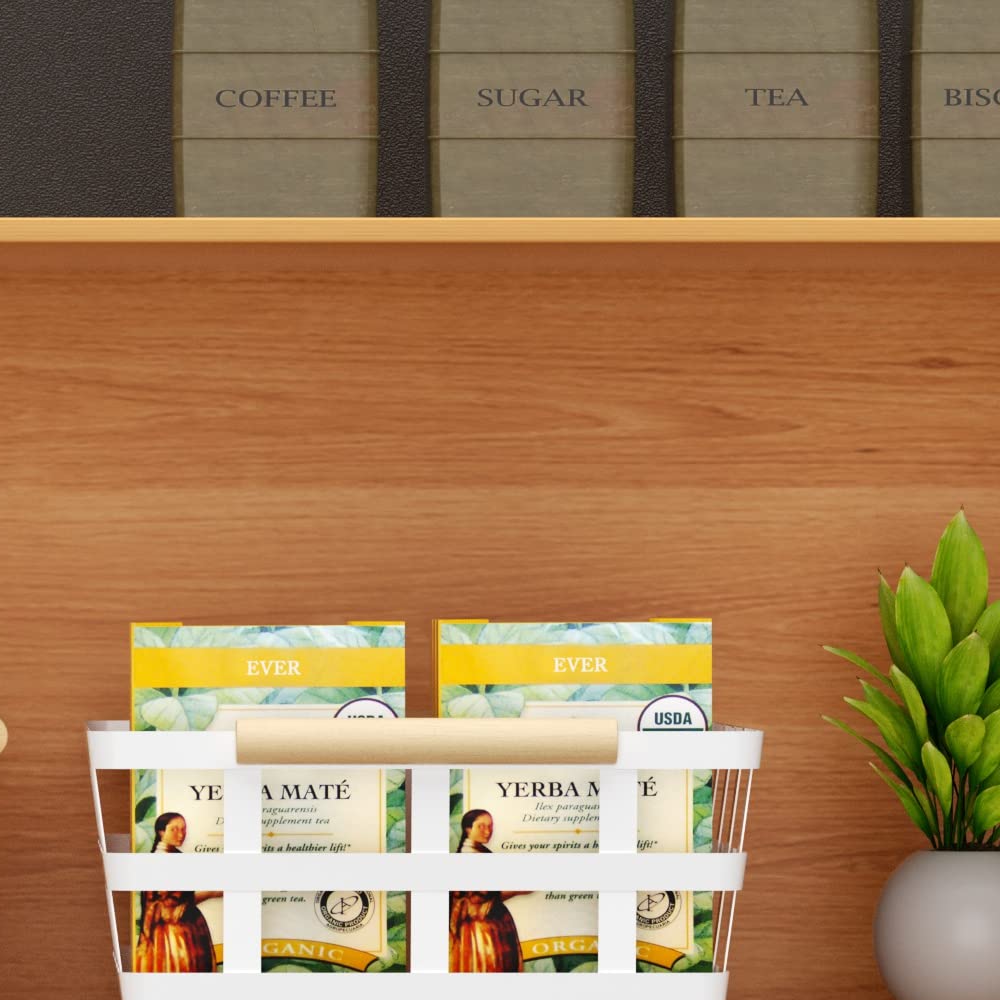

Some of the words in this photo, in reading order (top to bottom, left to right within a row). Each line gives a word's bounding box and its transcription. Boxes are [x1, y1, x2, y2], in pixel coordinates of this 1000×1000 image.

[214, 87, 338, 108] COFFEE
[477, 87, 590, 107] SUGAR
[744, 87, 810, 107] TEA
[246, 660, 302, 677] EVER
[553, 656, 609, 673] EVER
[654, 711, 693, 726] USDA
[190, 784, 274, 801] YEA
[281, 779, 352, 801] MATÉ
[496, 781, 580, 798] YERBA
[262, 805, 318, 817] raguarensis
[535, 802, 553, 811] Ilex
[556, 803, 600, 813] paragua
[261, 815, 312, 828] upplement
[315, 817, 331, 826] tea
[522, 813, 561, 824] Dietary
[563, 813, 600, 824] supplem
[285, 843, 328, 852] healthier
[501, 841, 527, 850] Gives
[529, 842, 551, 853] your
[552, 840, 581, 853] spirits
[261, 896, 287, 905] green
[545, 891, 567, 900] than
[568, 893, 594, 902] green
[262, 940, 345, 961] GANIC
[531, 938, 651, 958] ORGAC
